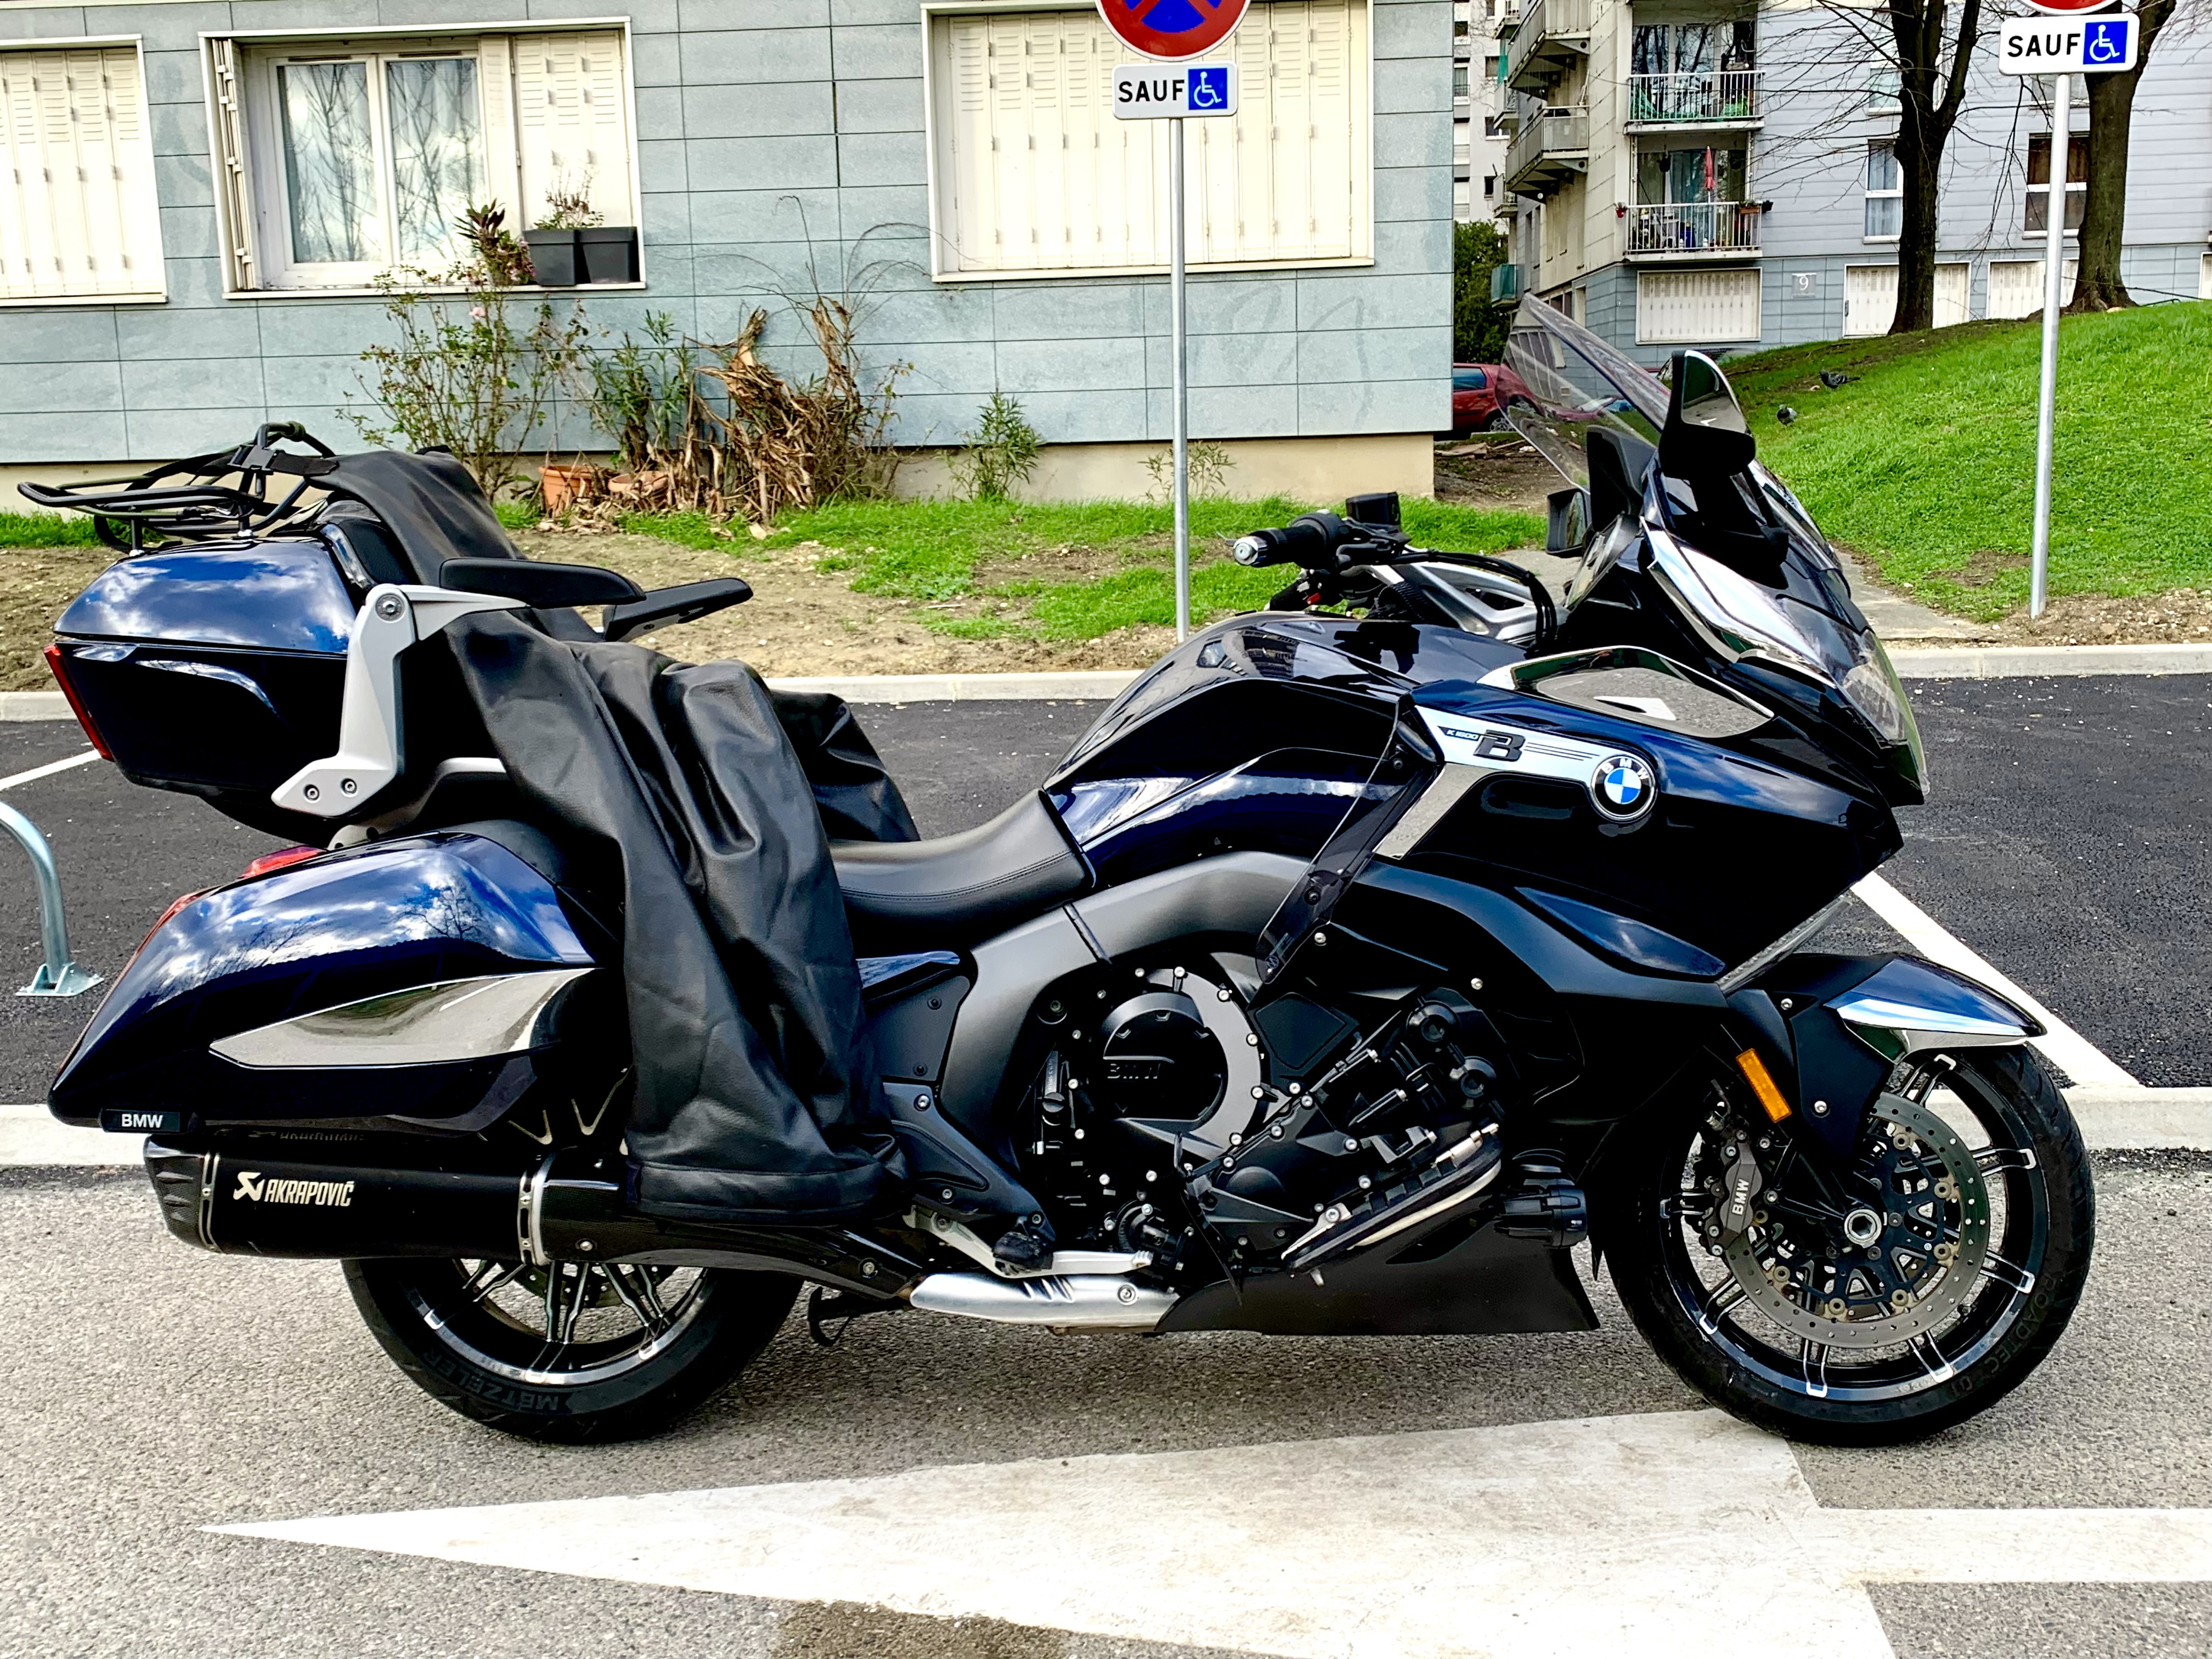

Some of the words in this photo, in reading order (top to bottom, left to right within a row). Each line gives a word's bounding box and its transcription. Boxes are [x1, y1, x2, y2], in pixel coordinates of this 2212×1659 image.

[2007, 33, 2081, 57] SAUF
[1118, 79, 1185, 103] SAUF
[1799, 276, 1808, 290] 9
[1455, 731, 1479, 740] 1600
[1473, 729, 1526, 762] B
[1601, 758, 1649, 780] BMW
[121, 1114, 163, 1128] BMW
[1732, 1178, 1750, 1215] BMW
[1983, 1273, 2056, 1374] ROADTEC
[420, 1351, 559, 1410] METZELER
